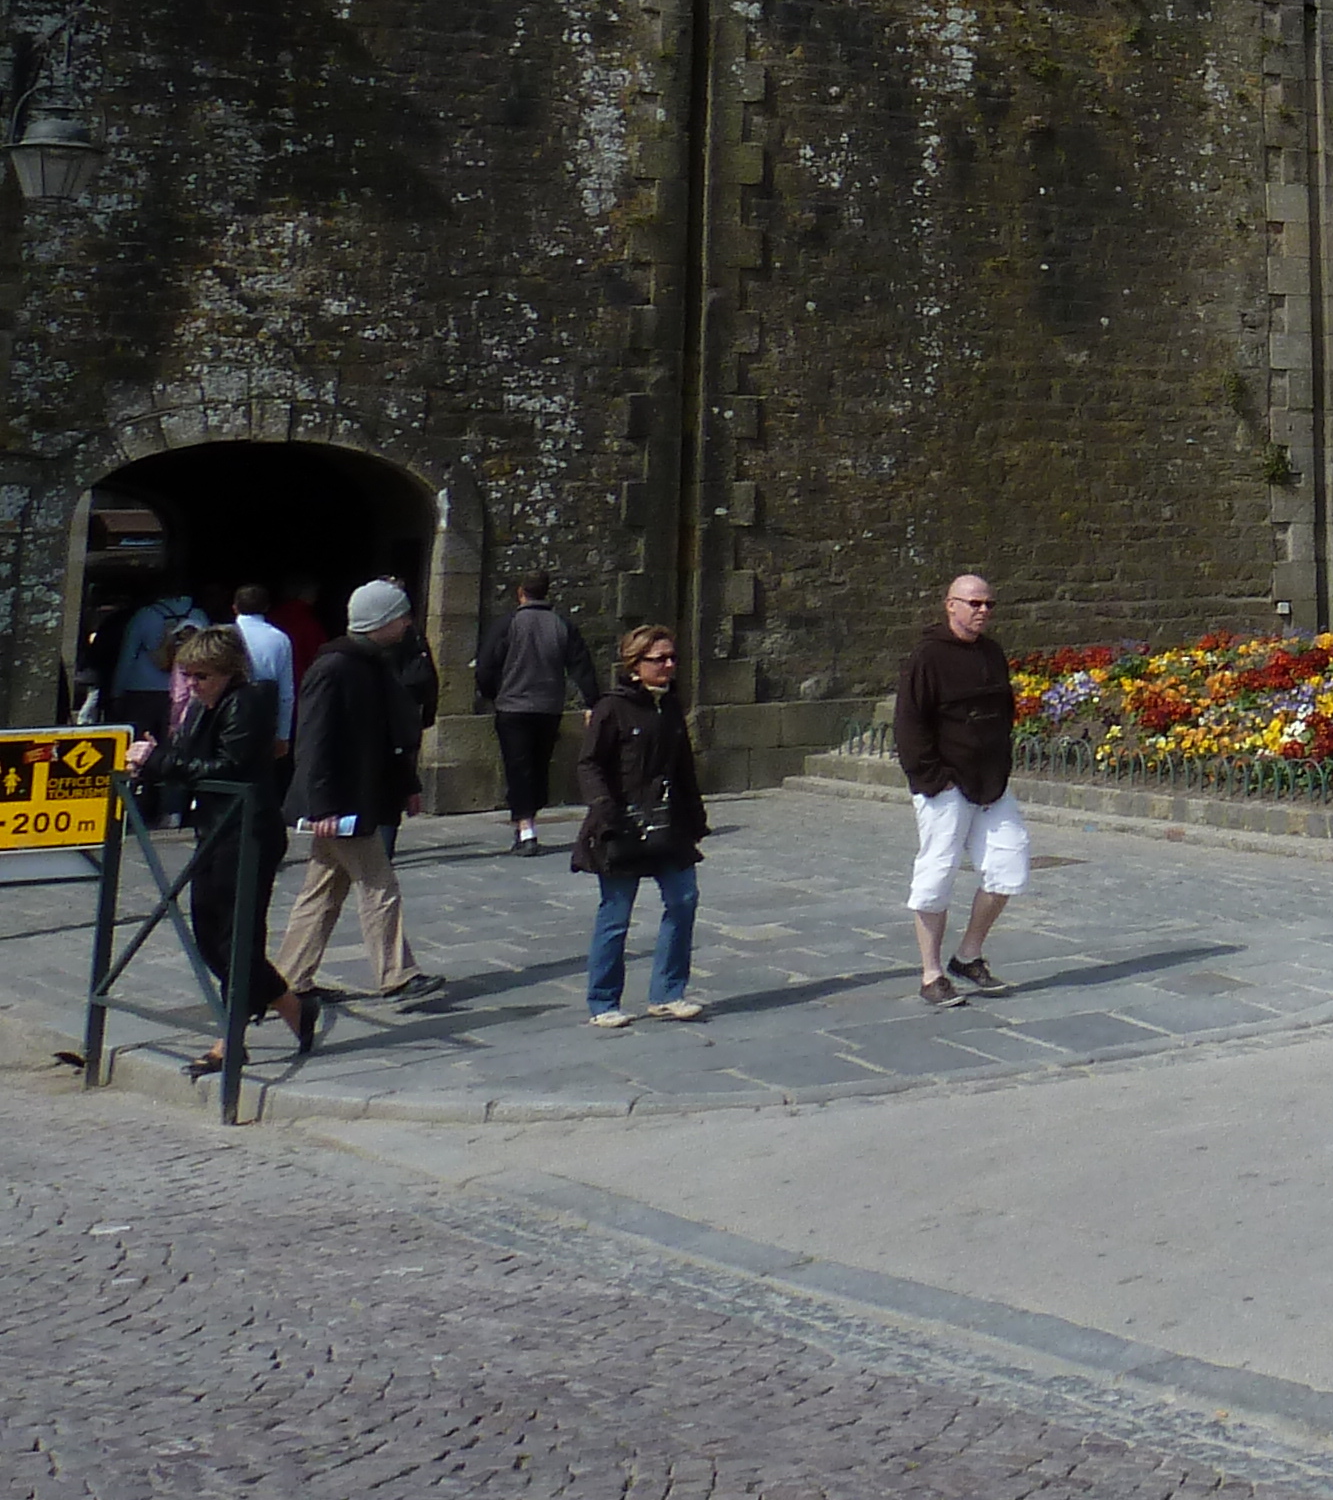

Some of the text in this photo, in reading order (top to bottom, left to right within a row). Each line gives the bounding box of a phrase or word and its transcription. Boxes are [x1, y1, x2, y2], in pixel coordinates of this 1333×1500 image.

[49, 776, 92, 788] OFFICE
[11, 810, 96, 835] 200 m
